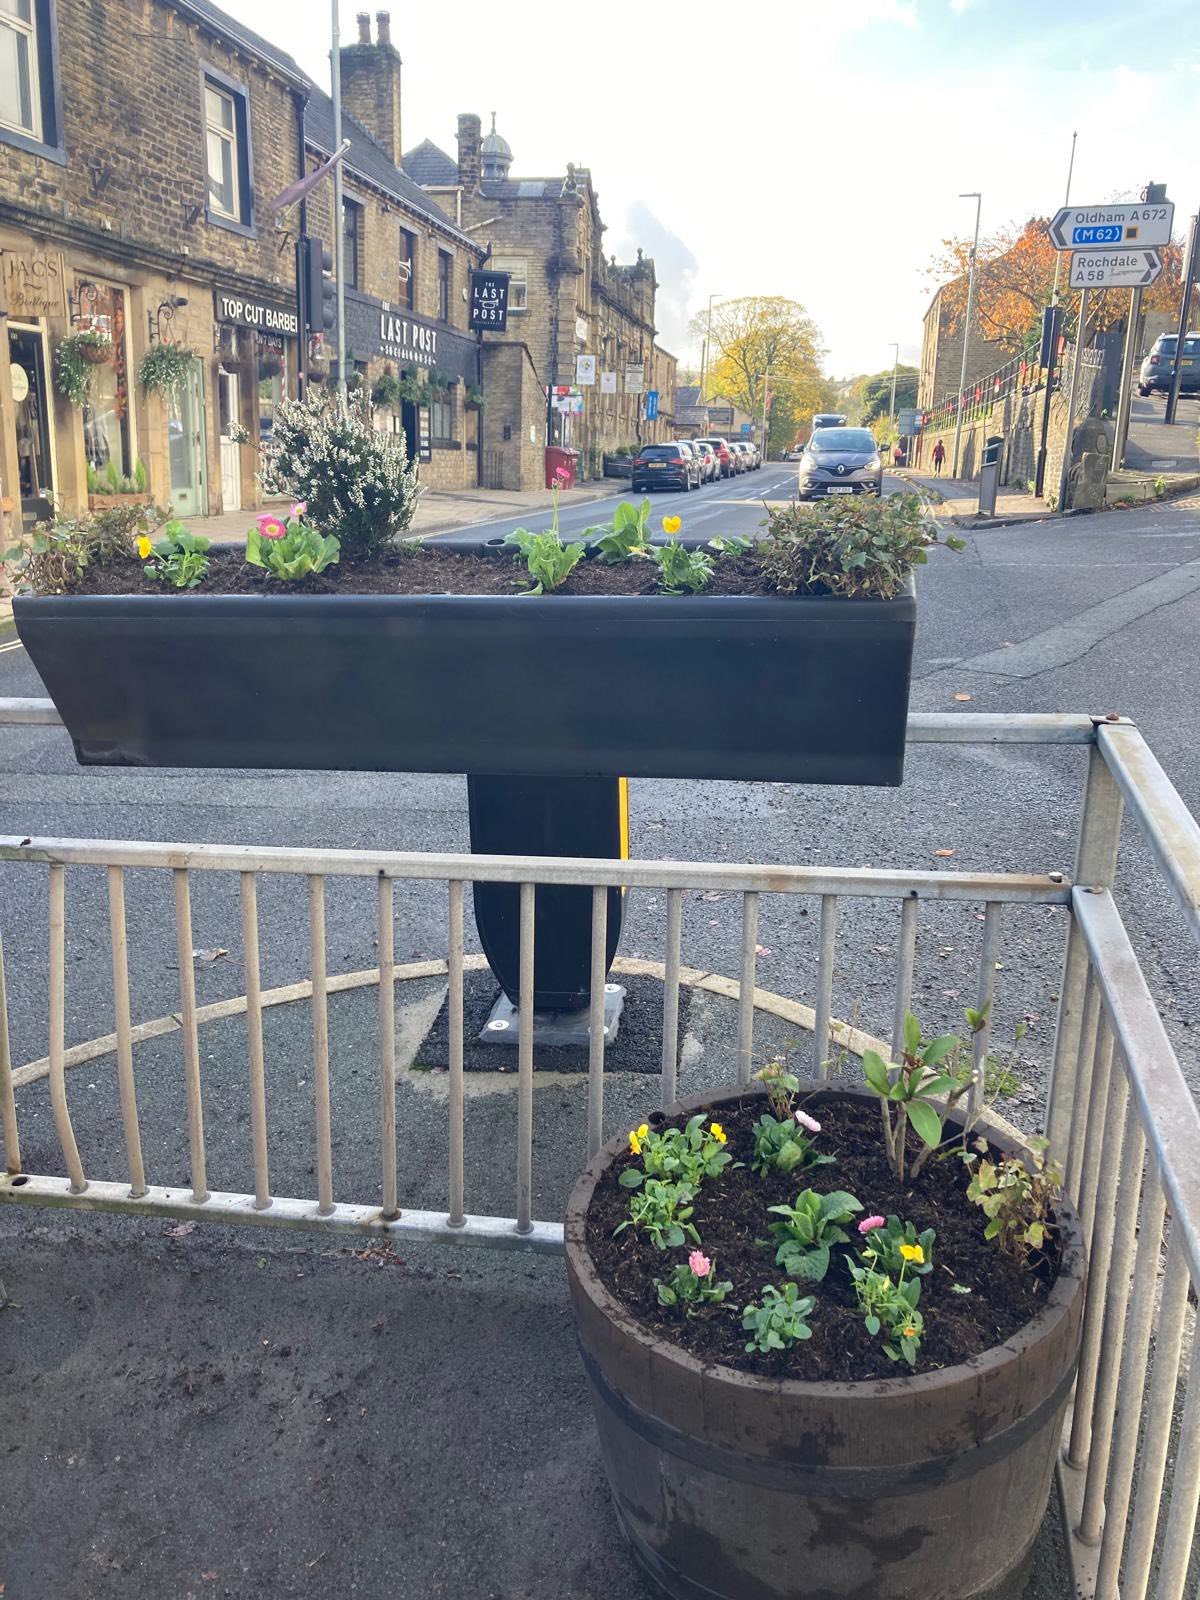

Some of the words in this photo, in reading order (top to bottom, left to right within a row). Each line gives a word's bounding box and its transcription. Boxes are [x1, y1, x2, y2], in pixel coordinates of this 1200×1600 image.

[1075, 212, 1125, 224] Oldham
[1077, 256, 1138, 268] Rochdale
[474, 287, 505, 300] LAST
[10, 292, 60, 311] Boutique
[222, 298, 243, 319] TOP
[244, 303, 264, 325] CUT
[473, 308, 504, 321] POST
[381, 313, 408, 345] LAST
[412, 324, 437, 353] POST
